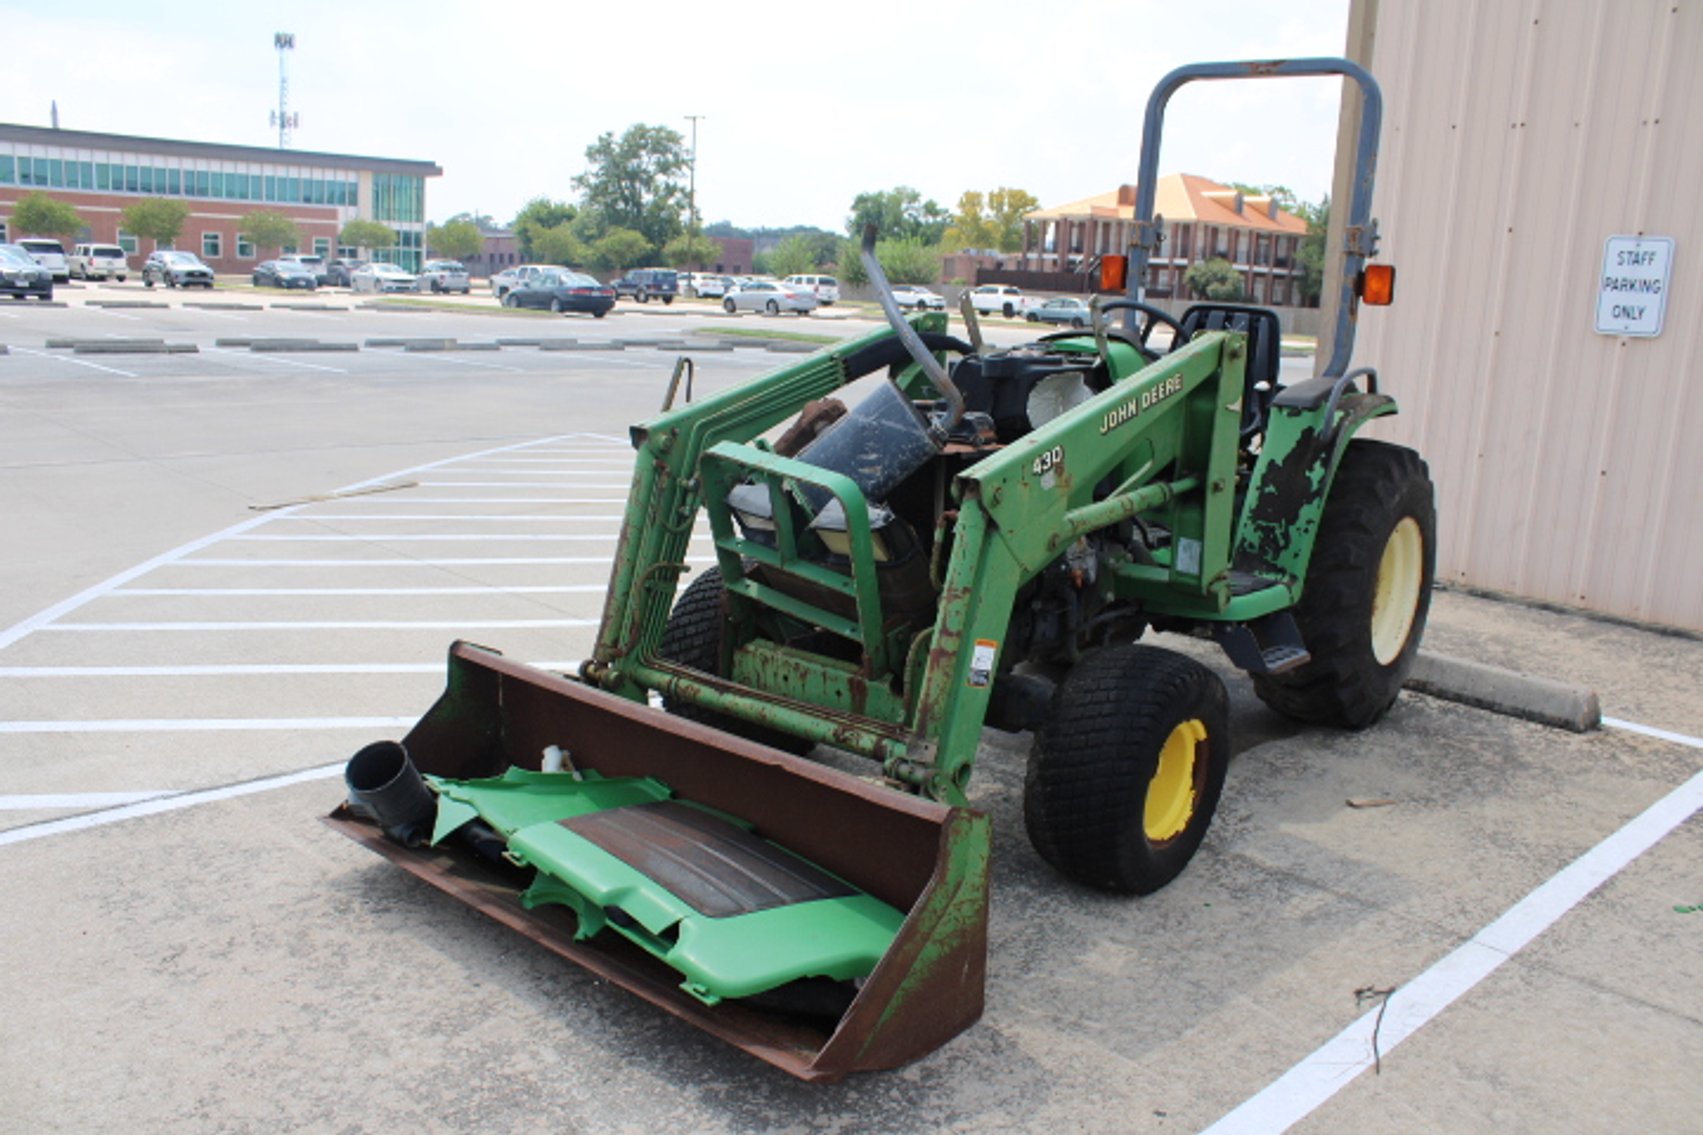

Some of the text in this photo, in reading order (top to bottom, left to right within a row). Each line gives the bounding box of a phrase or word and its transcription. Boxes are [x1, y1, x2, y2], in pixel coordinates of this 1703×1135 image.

[1617, 251, 1656, 265] STAFF
[1604, 277, 1661, 294] PARKING
[1612, 305, 1646, 320] ONLY
[1100, 374, 1183, 434] JOHN DEERE
[1032, 446, 1063, 475] 430
